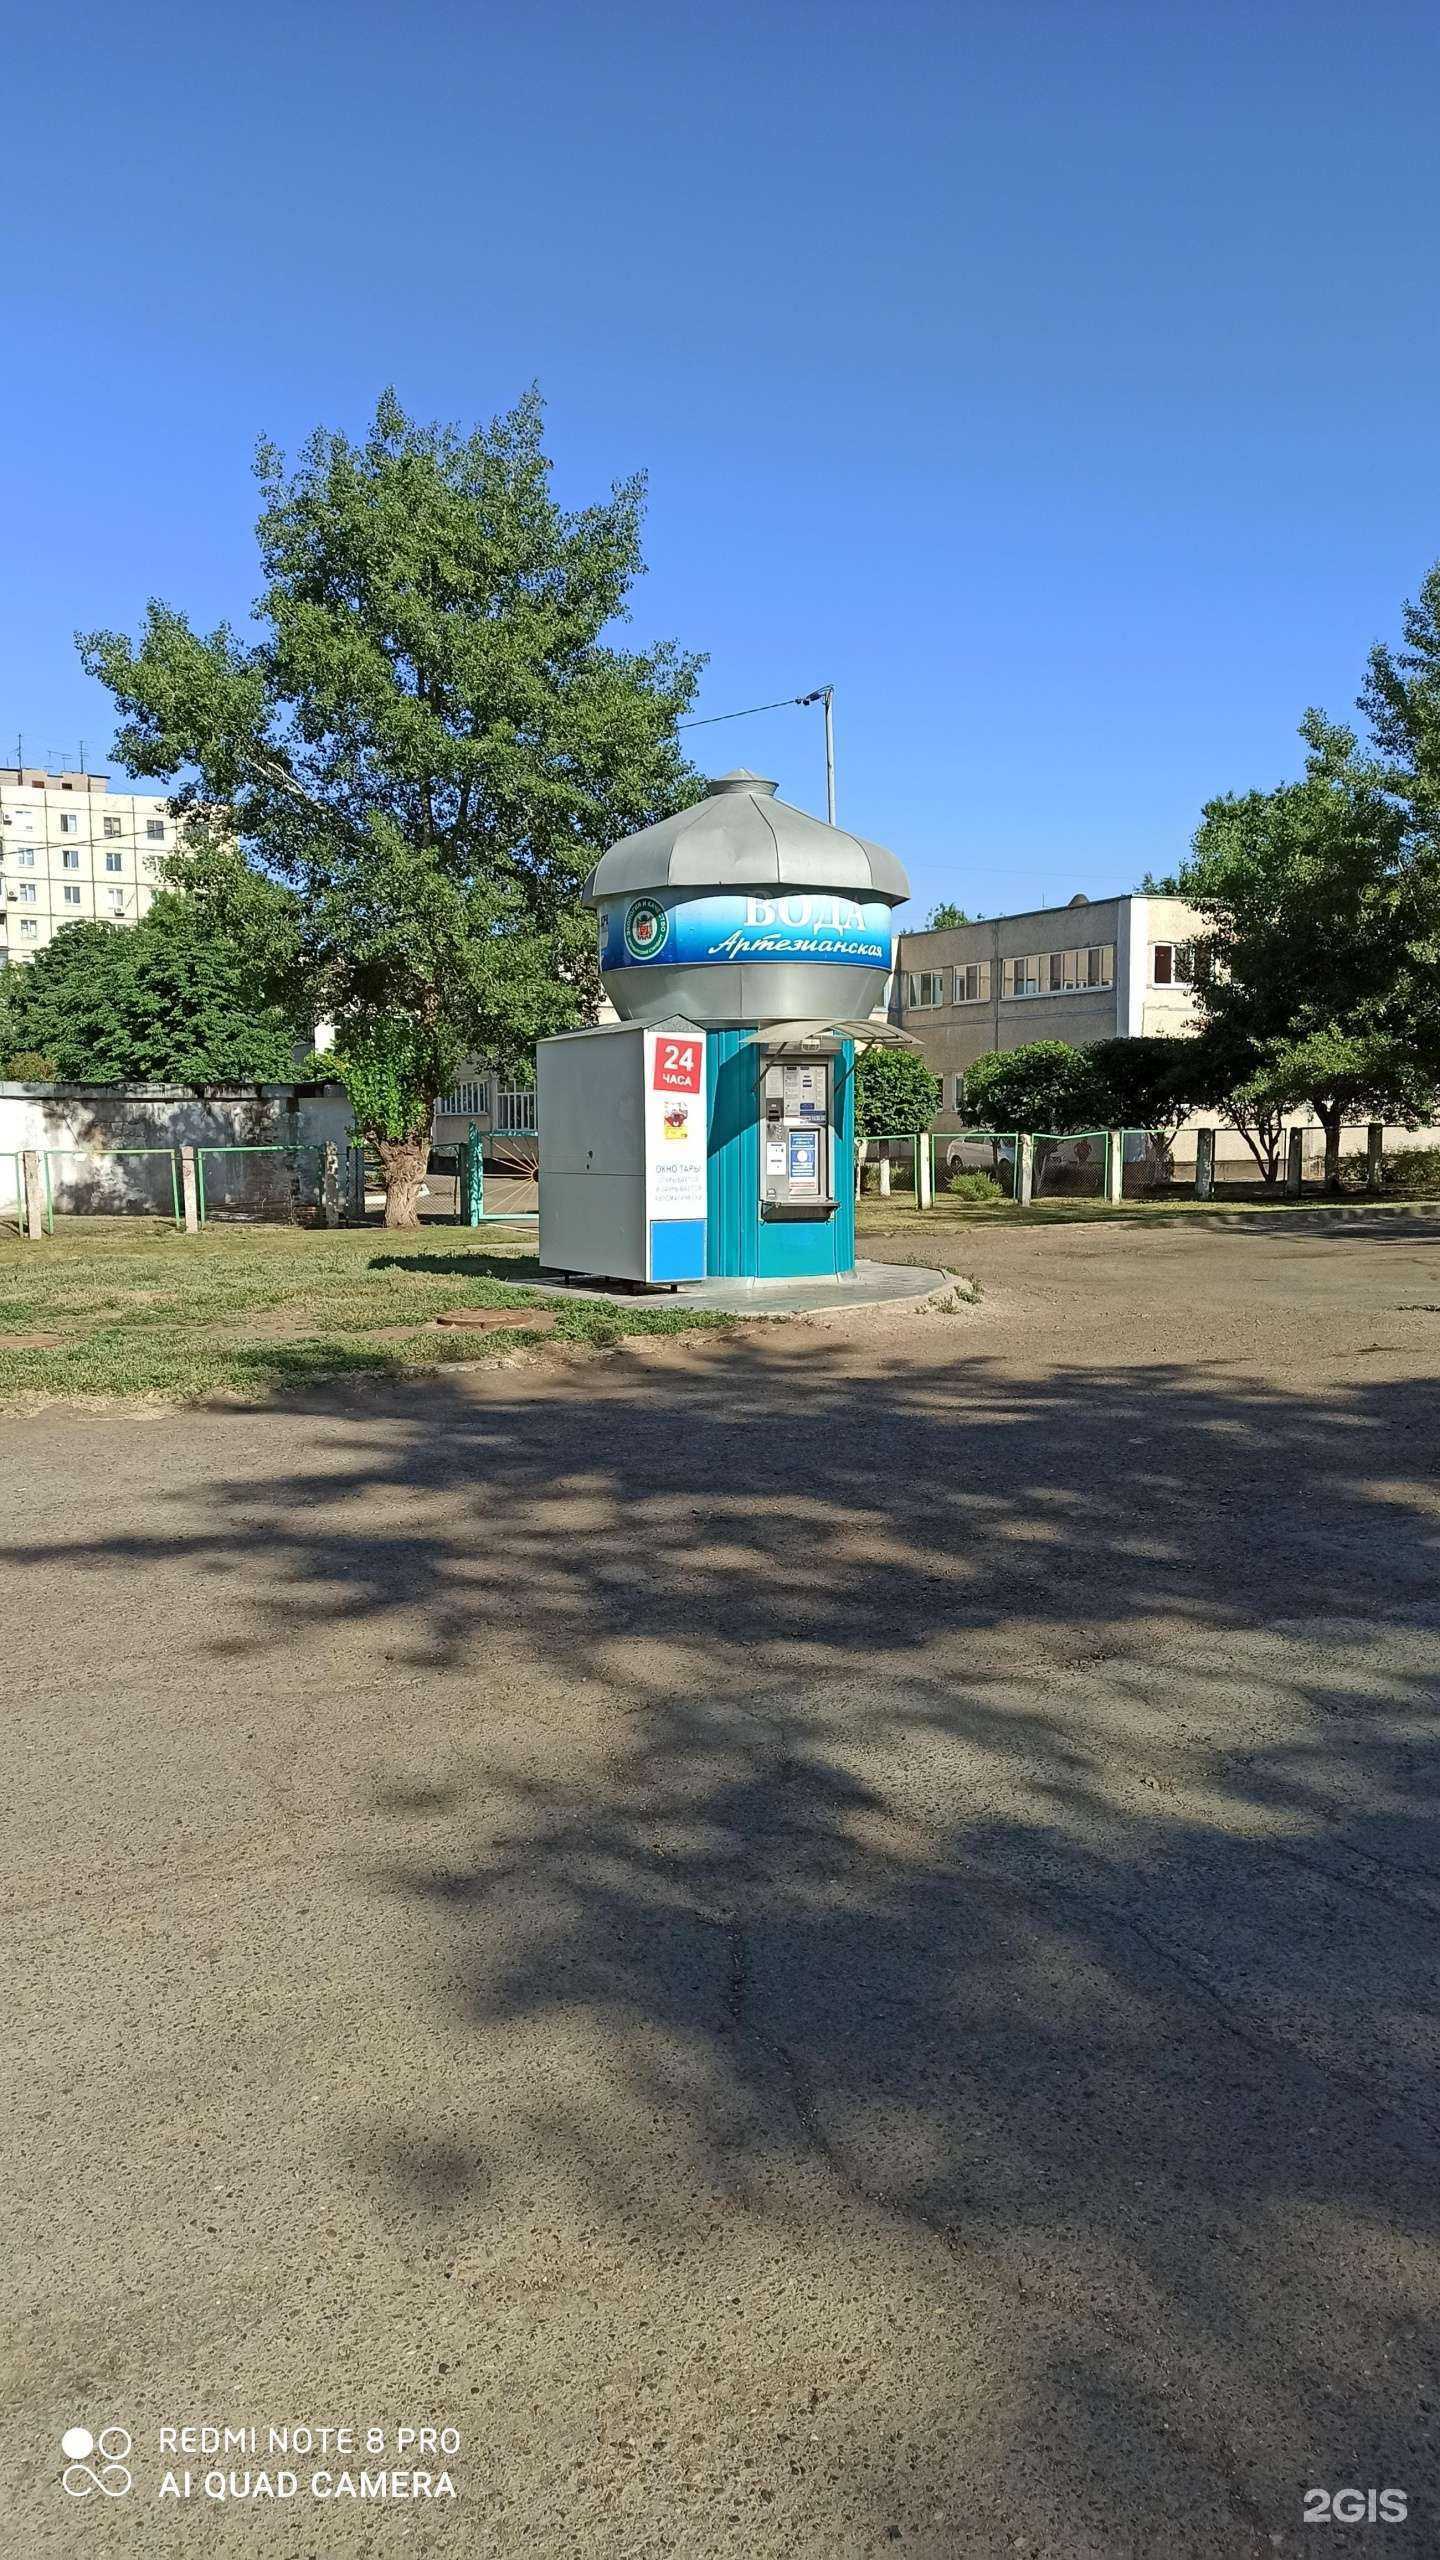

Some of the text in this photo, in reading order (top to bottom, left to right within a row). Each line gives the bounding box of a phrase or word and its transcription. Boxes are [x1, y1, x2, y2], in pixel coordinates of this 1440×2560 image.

[744, 890, 866, 936] ВОДА
[708, 929, 883, 960] Артезианская
[663, 1044, 695, 1072] 24
[662, 1073, 692, 1087] ЧАСА
[655, 1164, 678, 1174] ОКНО
